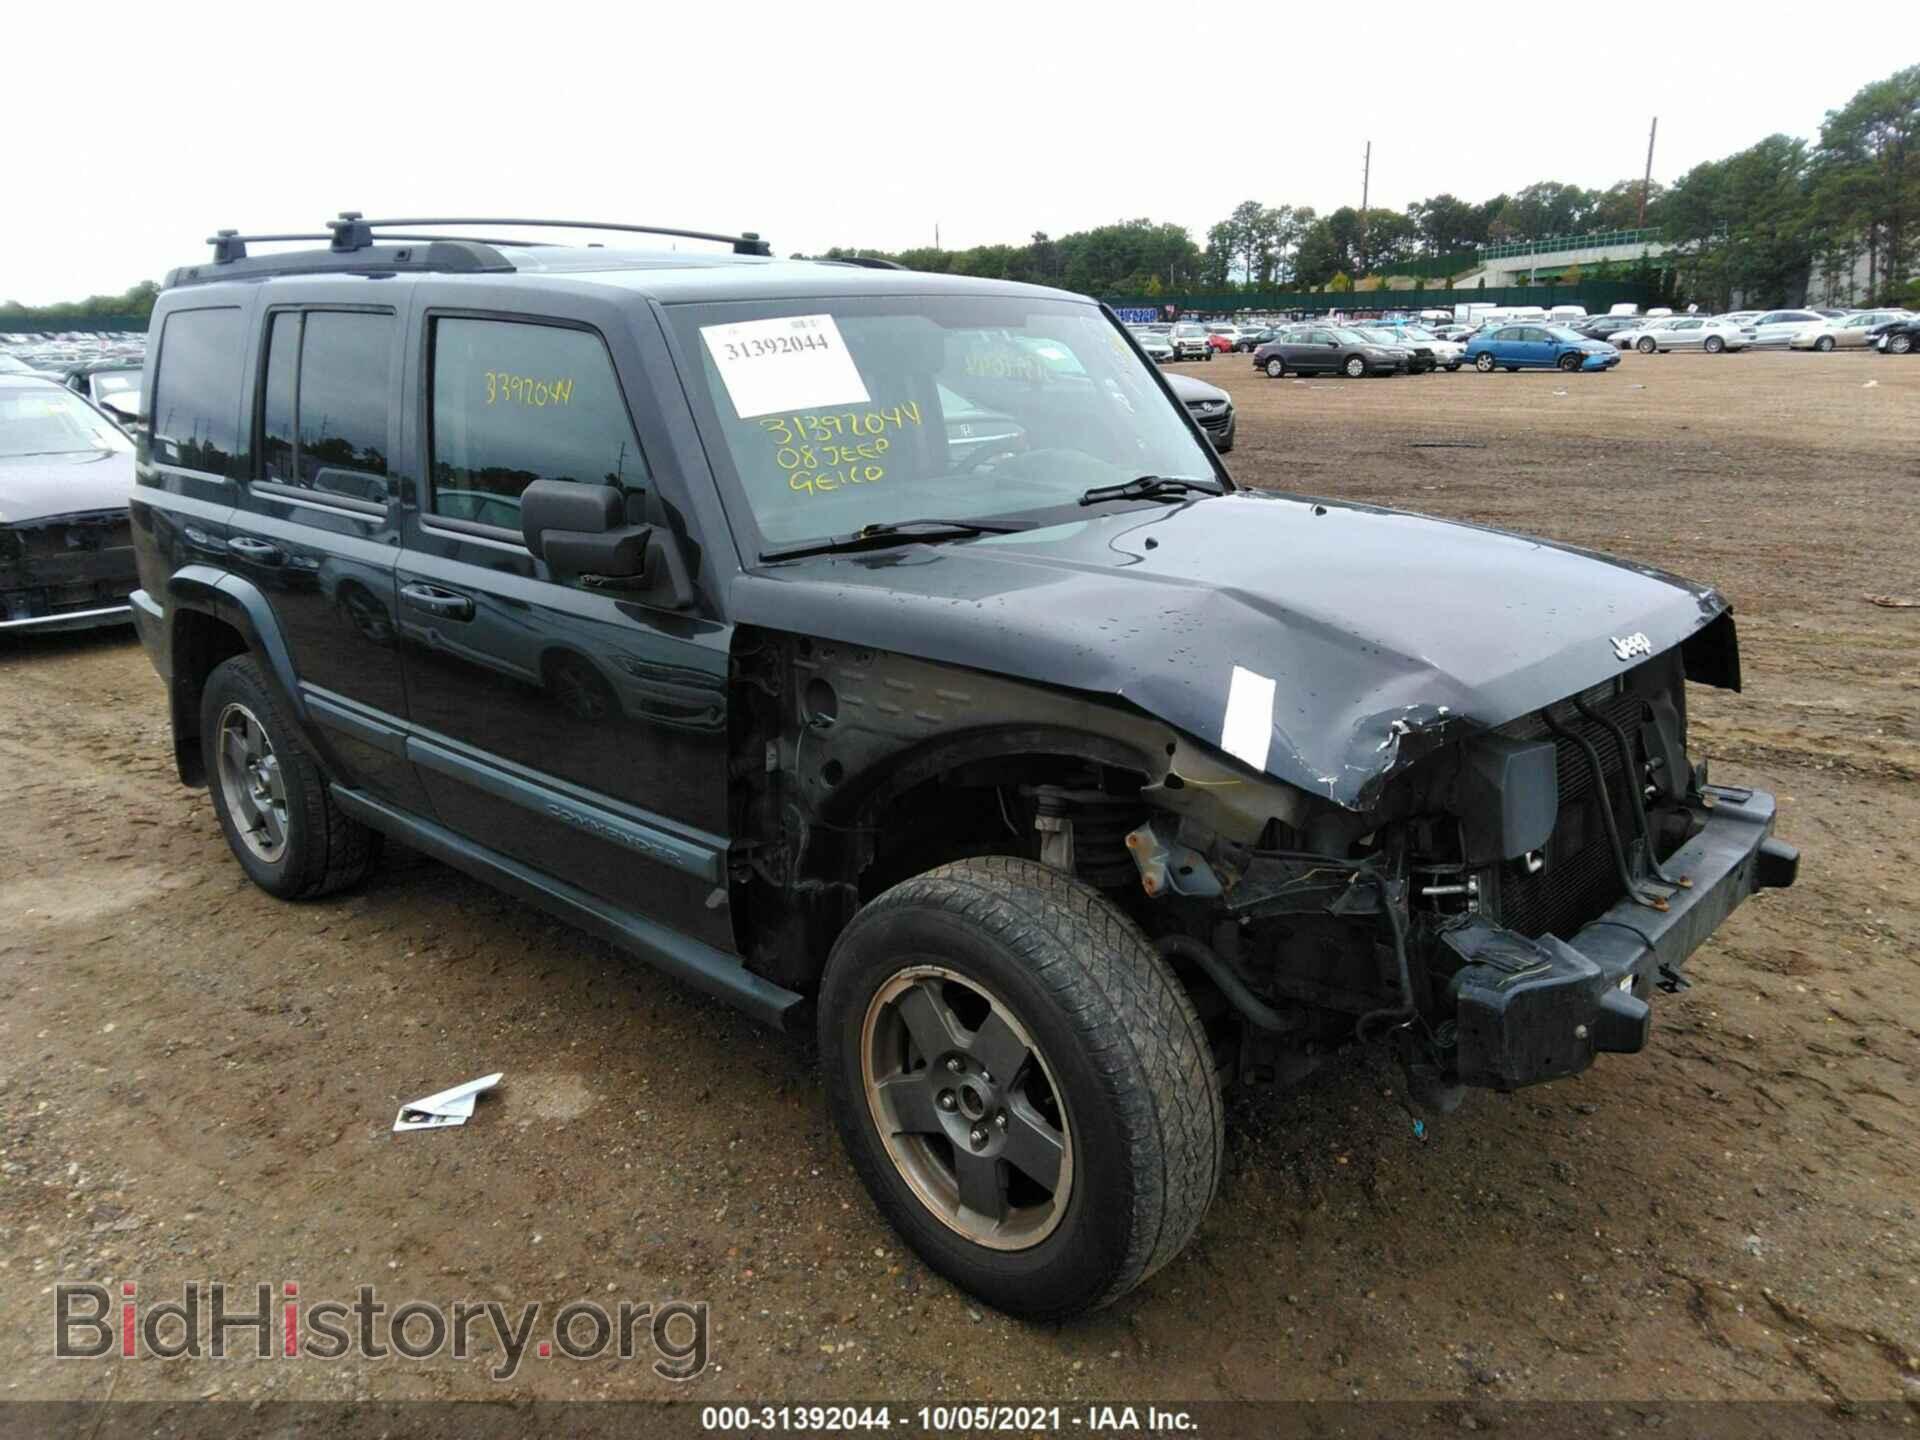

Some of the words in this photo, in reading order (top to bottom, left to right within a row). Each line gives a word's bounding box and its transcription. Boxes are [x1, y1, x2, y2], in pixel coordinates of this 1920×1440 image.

[724, 333, 829, 361] 31392044
[760, 400, 921, 445] 31392044
[777, 444, 819, 469] 08
[821, 438, 889, 466] JEEP
[790, 466, 884, 496] GEICO
[1610, 632, 1651, 661] Jeep
